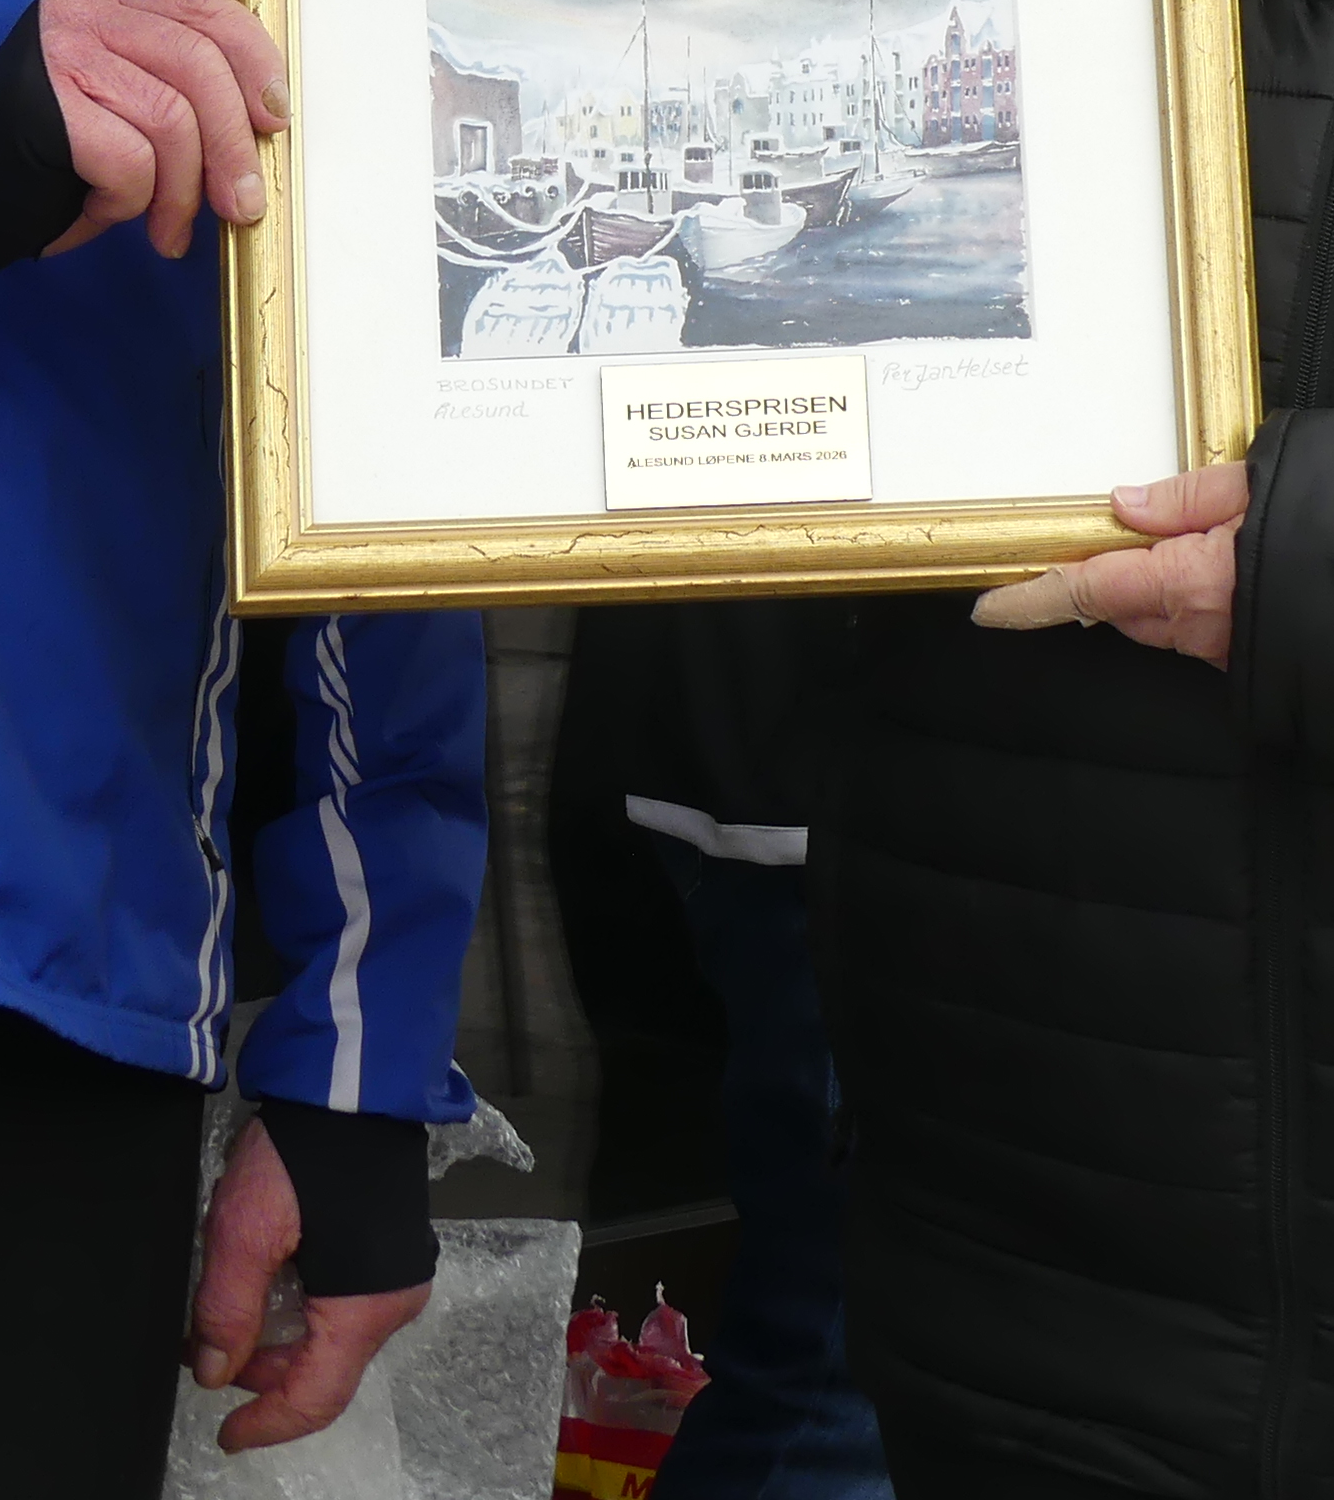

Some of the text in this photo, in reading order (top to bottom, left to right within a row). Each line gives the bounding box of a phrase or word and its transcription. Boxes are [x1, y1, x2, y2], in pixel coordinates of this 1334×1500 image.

[436, 377, 574, 392] BROSUNDET
[626, 395, 848, 421] HEDERSPRISEN
[648, 420, 828, 441] SUSAN GJERDE
[626, 455, 694, 469] ÅLESUND
[698, 454, 755, 465] LØPENE
[815, 450, 848, 461] 2026
